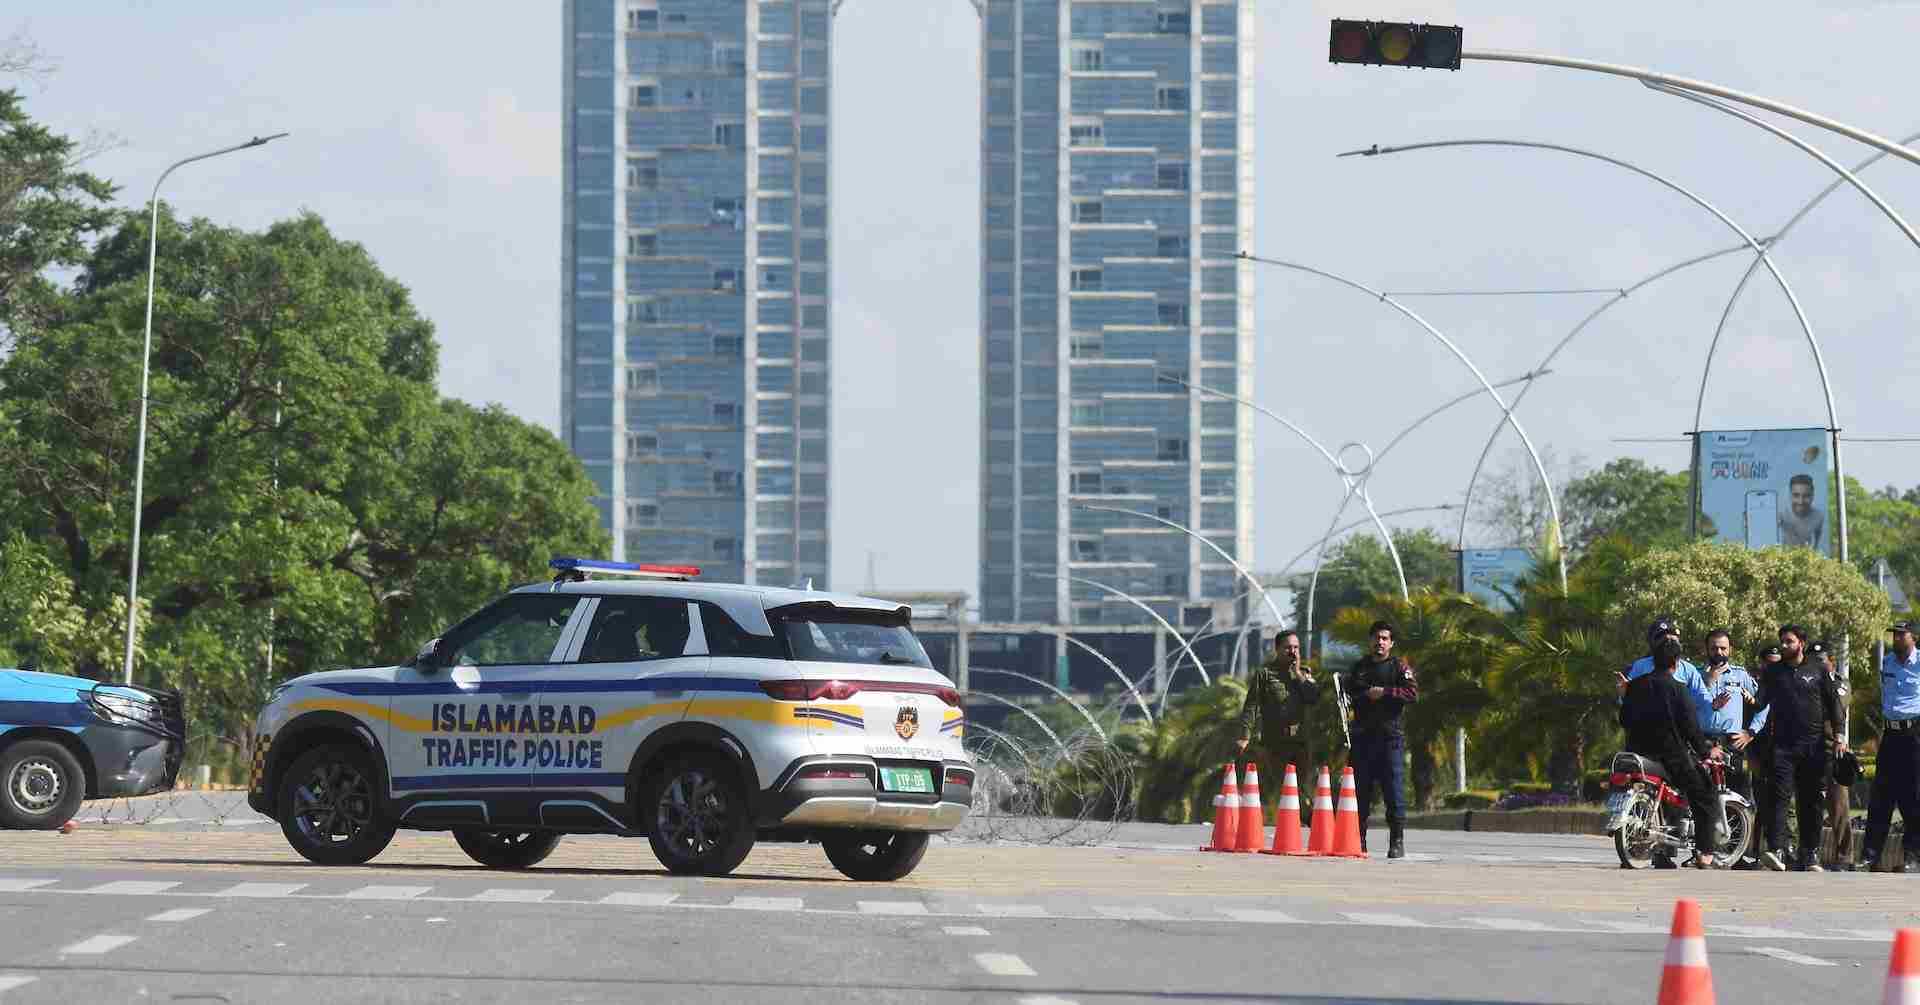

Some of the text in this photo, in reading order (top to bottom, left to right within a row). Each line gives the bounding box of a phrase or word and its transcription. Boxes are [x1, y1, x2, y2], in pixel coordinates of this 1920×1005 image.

[432, 703, 596, 734] ISLAMABAD
[422, 738, 603, 769] TRAFFIC POLICE
